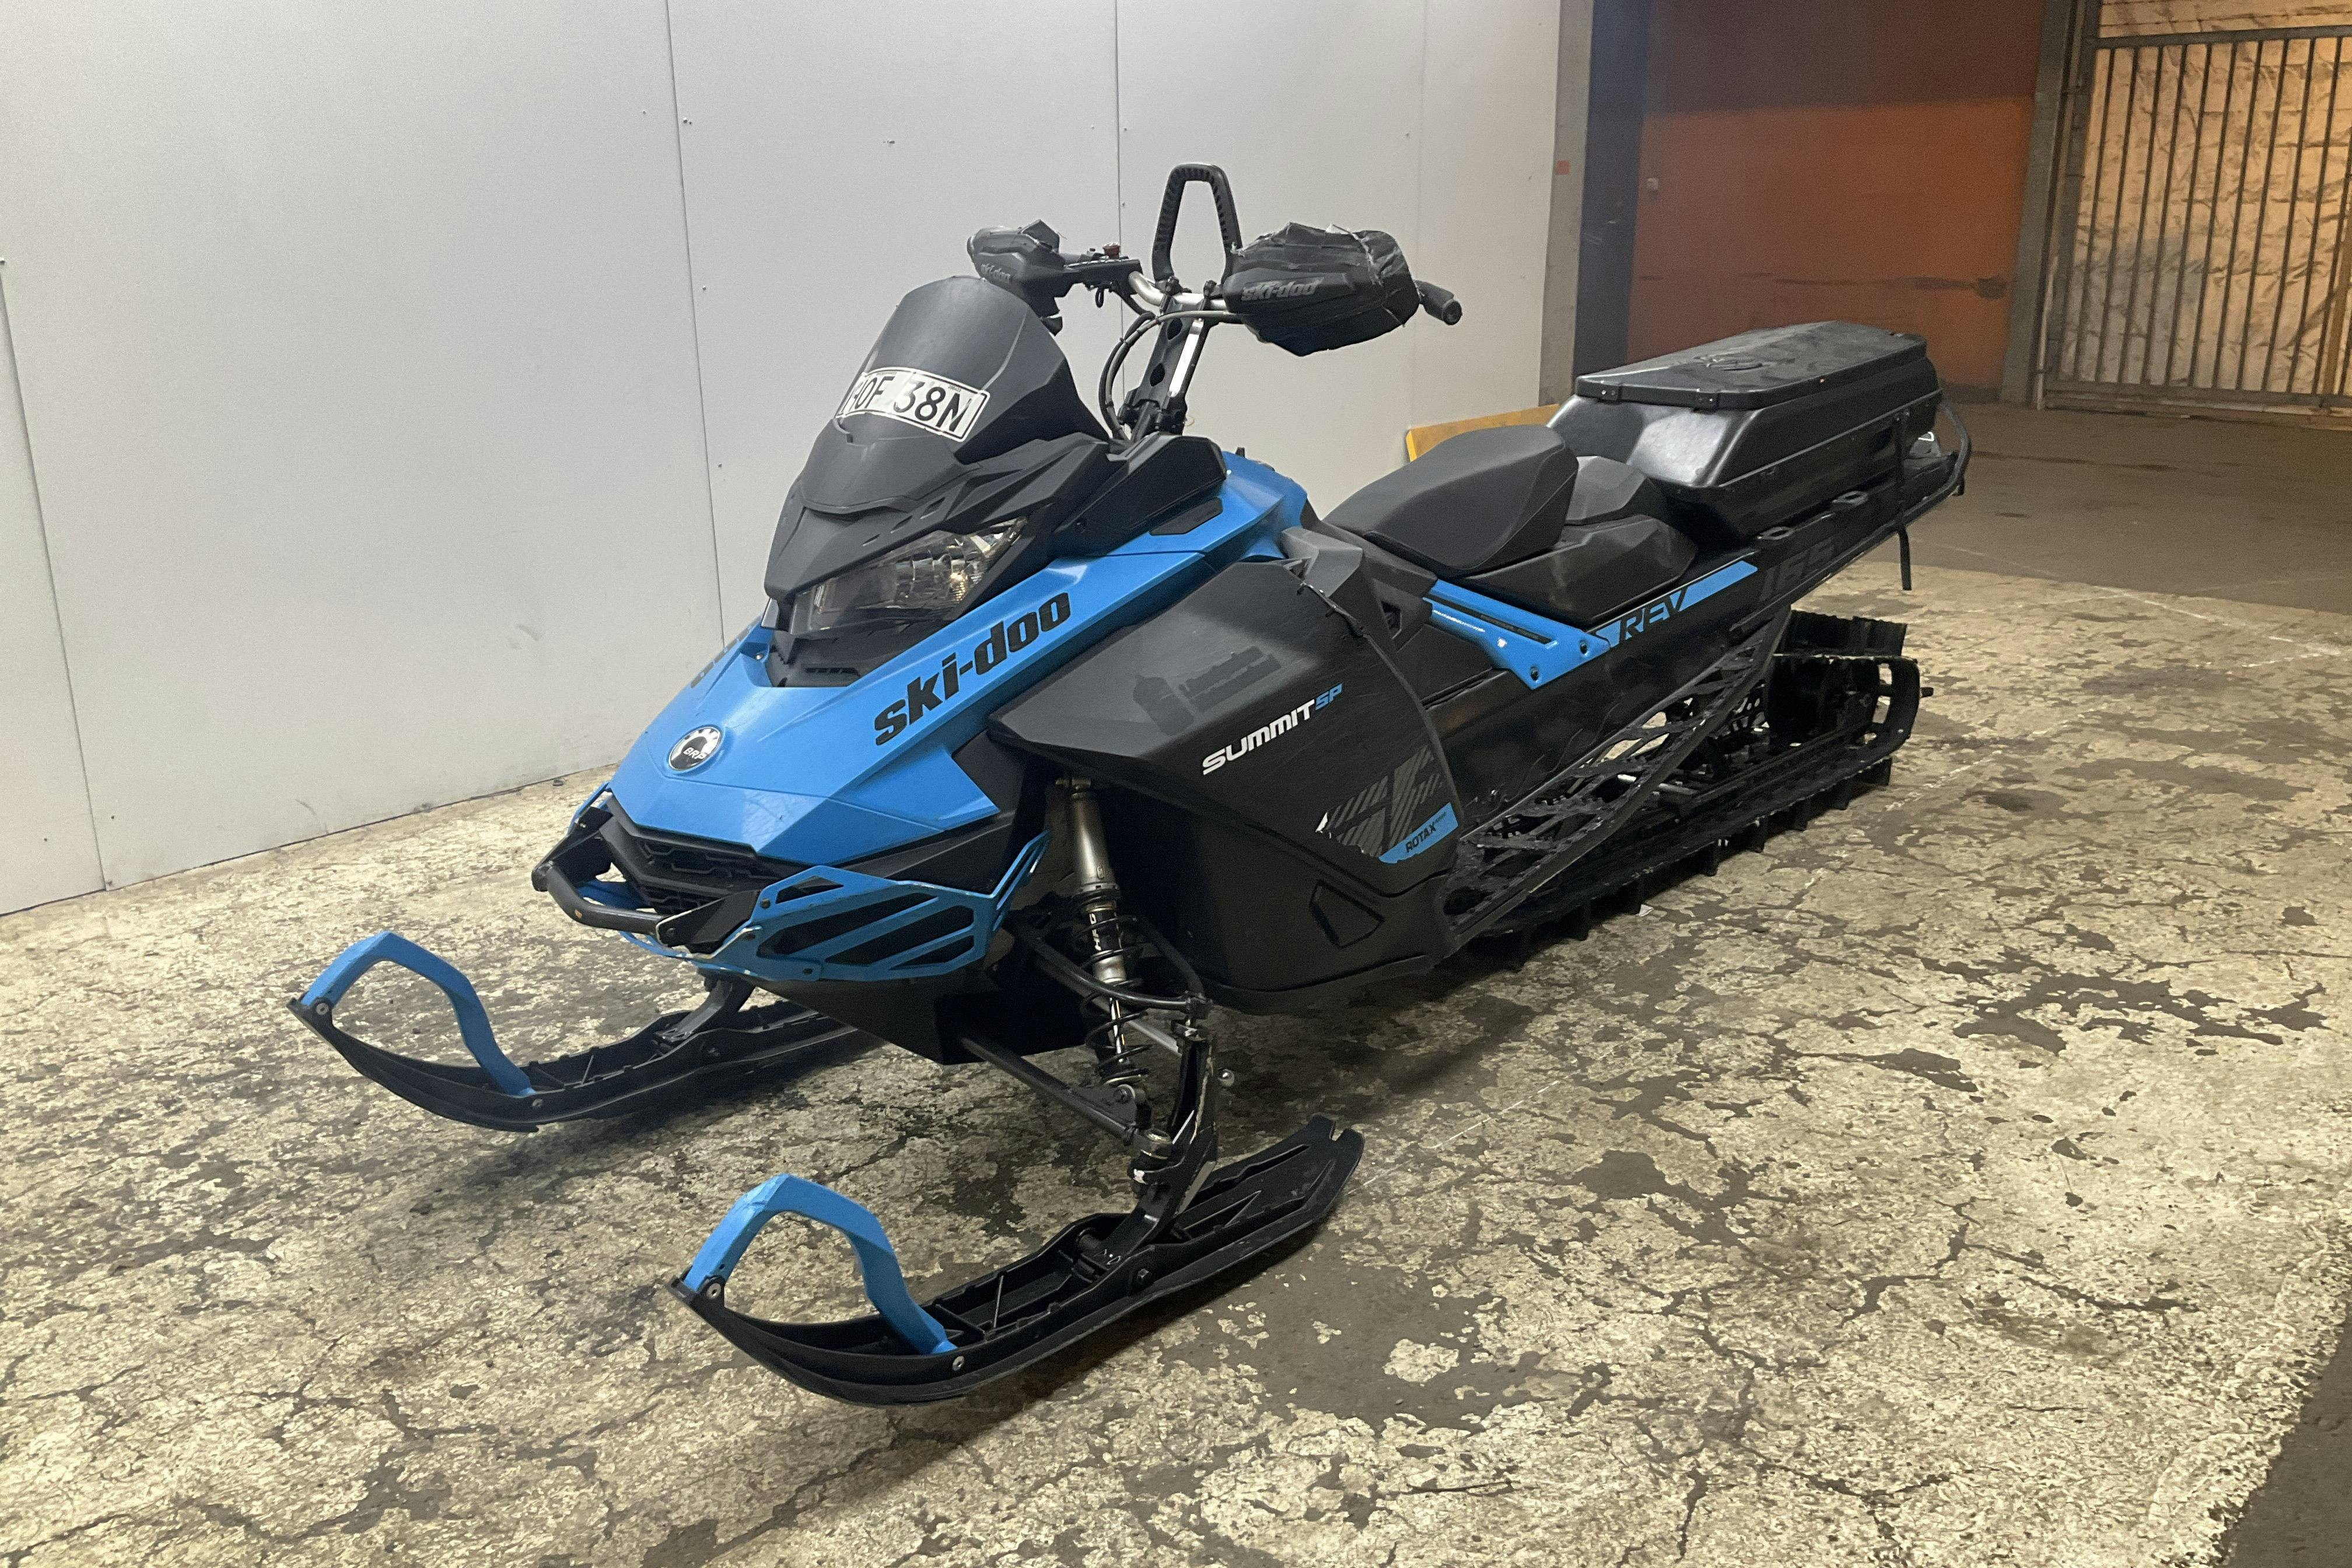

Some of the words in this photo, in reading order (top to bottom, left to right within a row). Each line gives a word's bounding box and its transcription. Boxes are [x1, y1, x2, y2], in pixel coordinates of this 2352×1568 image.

[1241, 279, 1319, 301] ski-doo
[893, 380, 972, 432] 38N
[1618, 584, 1689, 643] REV
[874, 592, 1071, 746] ski-doo
[683, 747, 708, 760] BRP
[1202, 699, 1315, 776] SUMMIT
[1405, 821, 1436, 853] ROTAX
